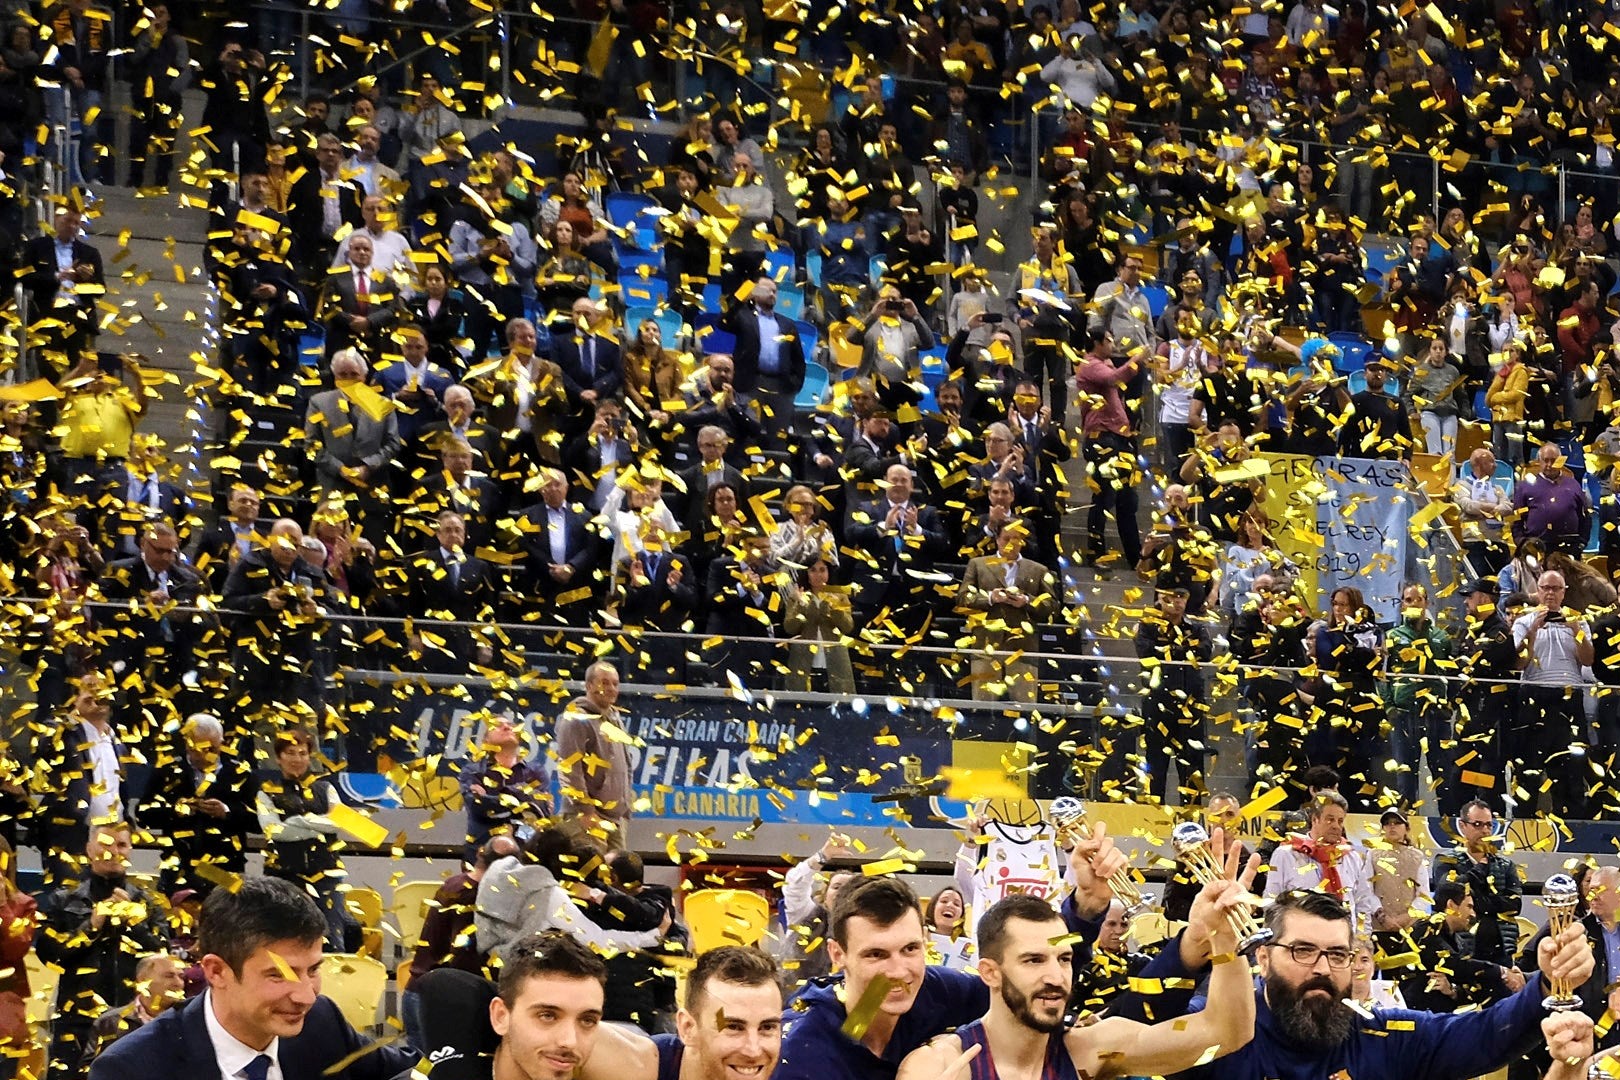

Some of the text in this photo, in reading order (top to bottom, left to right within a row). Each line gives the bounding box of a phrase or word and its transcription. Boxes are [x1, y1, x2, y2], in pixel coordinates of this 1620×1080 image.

[1345, 525, 1390, 550] REY
[638, 717, 672, 740] REY
[674, 719, 720, 742] GRAN
[674, 791, 760, 817] CANARIA
